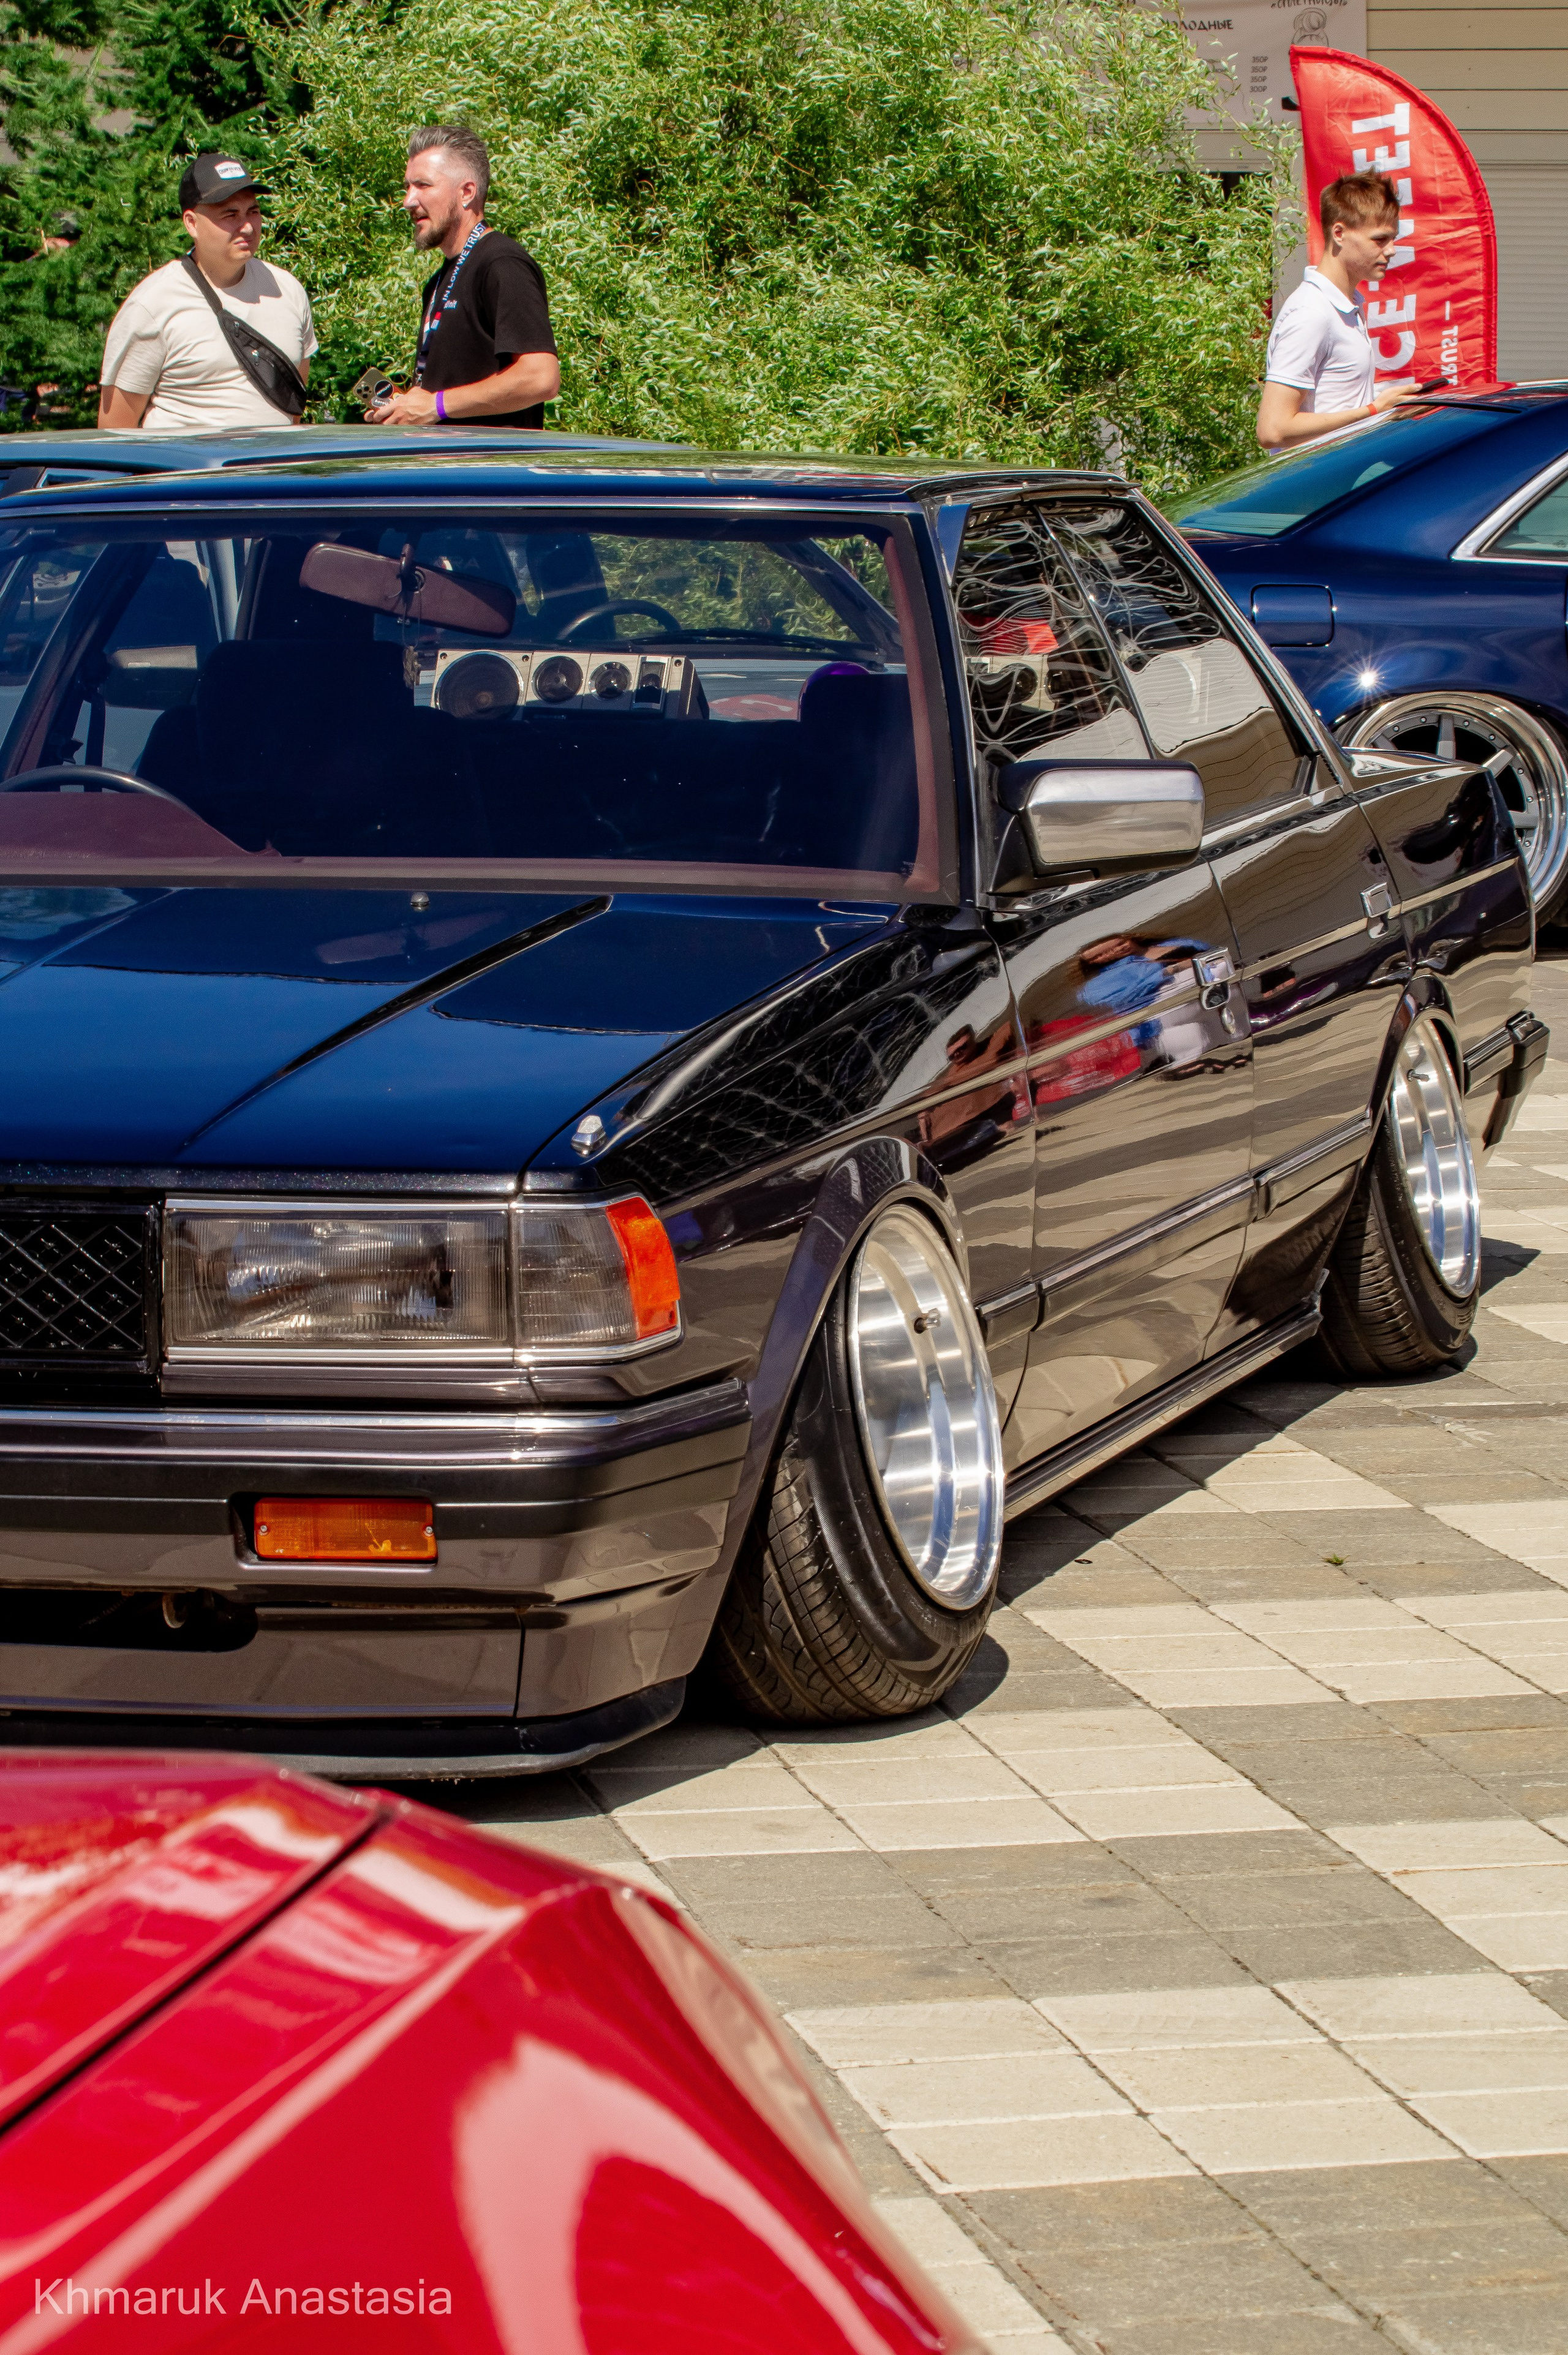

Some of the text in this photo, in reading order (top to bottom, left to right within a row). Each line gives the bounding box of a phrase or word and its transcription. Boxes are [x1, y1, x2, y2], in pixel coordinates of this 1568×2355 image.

[442, 290, 451, 302] IN
[447, 266, 460, 290] LOW
[456, 249, 471, 266] WE
